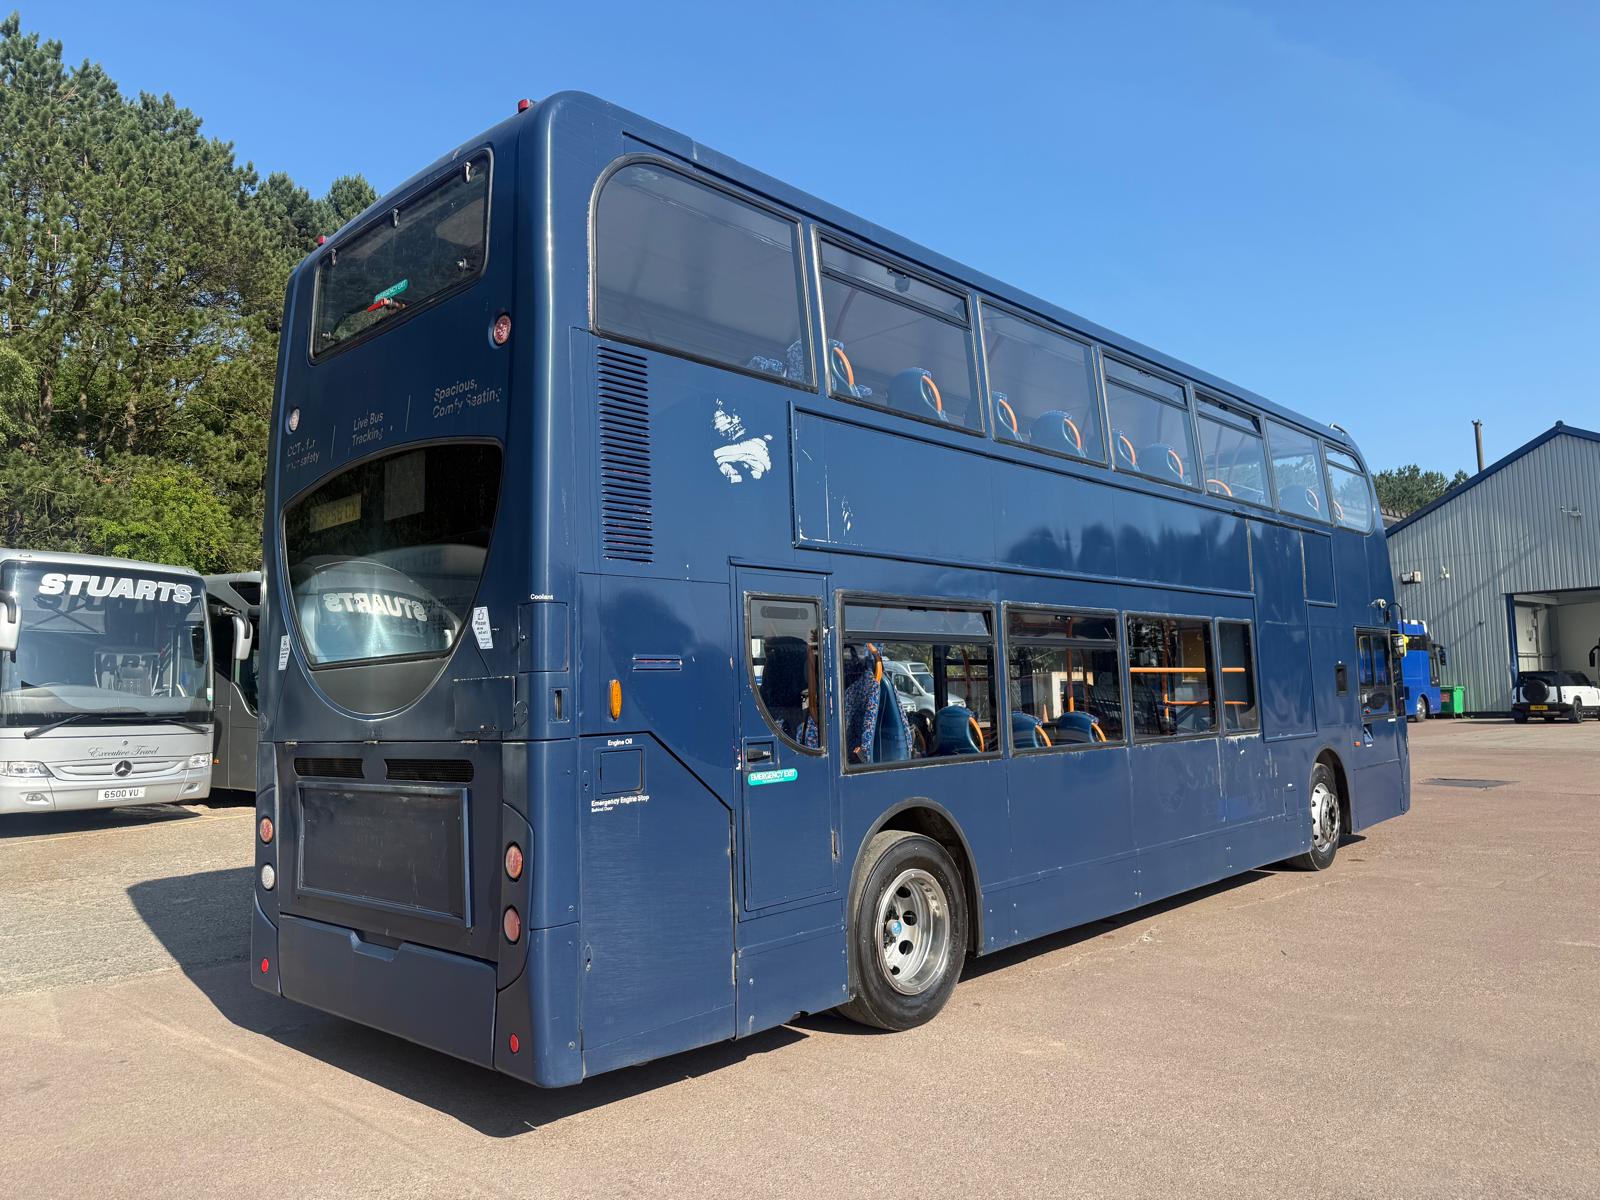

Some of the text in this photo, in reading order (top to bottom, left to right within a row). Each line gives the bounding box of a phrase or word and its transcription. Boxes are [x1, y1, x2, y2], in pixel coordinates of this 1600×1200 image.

[434, 379, 477, 403] Spacious,
[353, 412, 384, 431] Live Bus
[38, 573, 193, 604] STUARTS
[607, 739, 625, 747] Engine
[88, 745, 160, 757] Executive Travel
[750, 770, 783, 780] EMERGENCY
[104, 789, 127, 799] 6500
[591, 798, 620, 807] Emergency
[620, 796, 638, 804] Engine
